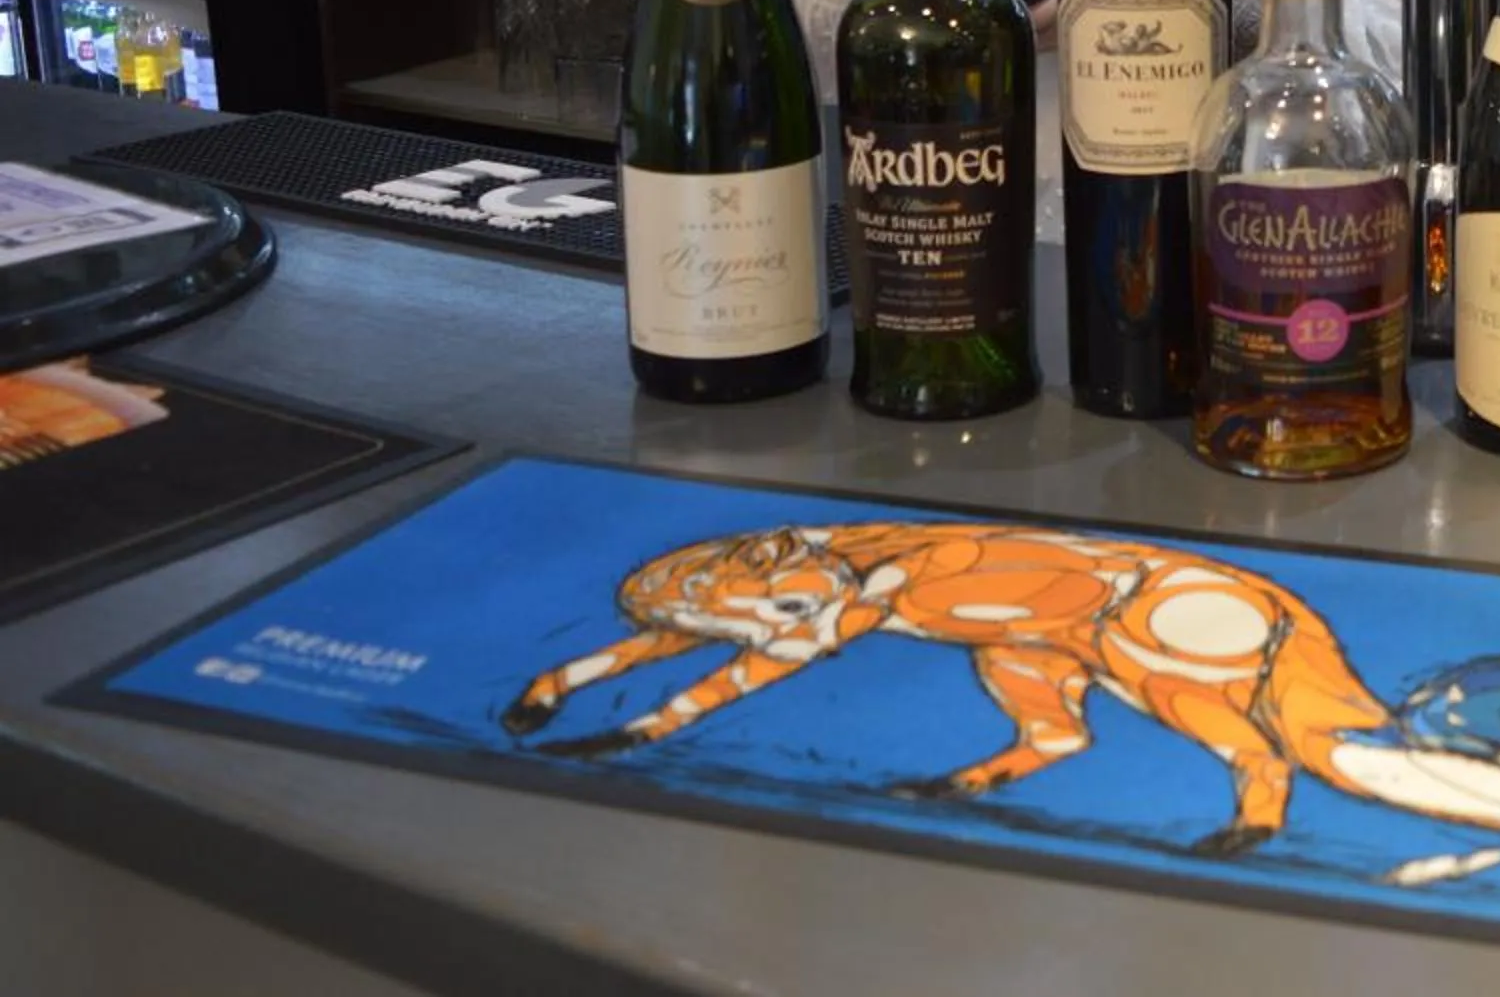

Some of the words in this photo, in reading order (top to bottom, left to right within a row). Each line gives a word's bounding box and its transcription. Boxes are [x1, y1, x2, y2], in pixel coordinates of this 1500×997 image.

[1075, 59, 1096, 79] EL
[1103, 59, 1206, 83] ENEMIGO
[891, 215, 948, 230] SINGLE
[952, 211, 995, 229] MALT
[863, 227, 916, 246] SCOTCH
[918, 229, 984, 247] WHISKY
[898, 250, 943, 266] TEN
[1297, 317, 1341, 344] 12
[252, 625, 428, 673] PREMIUM
